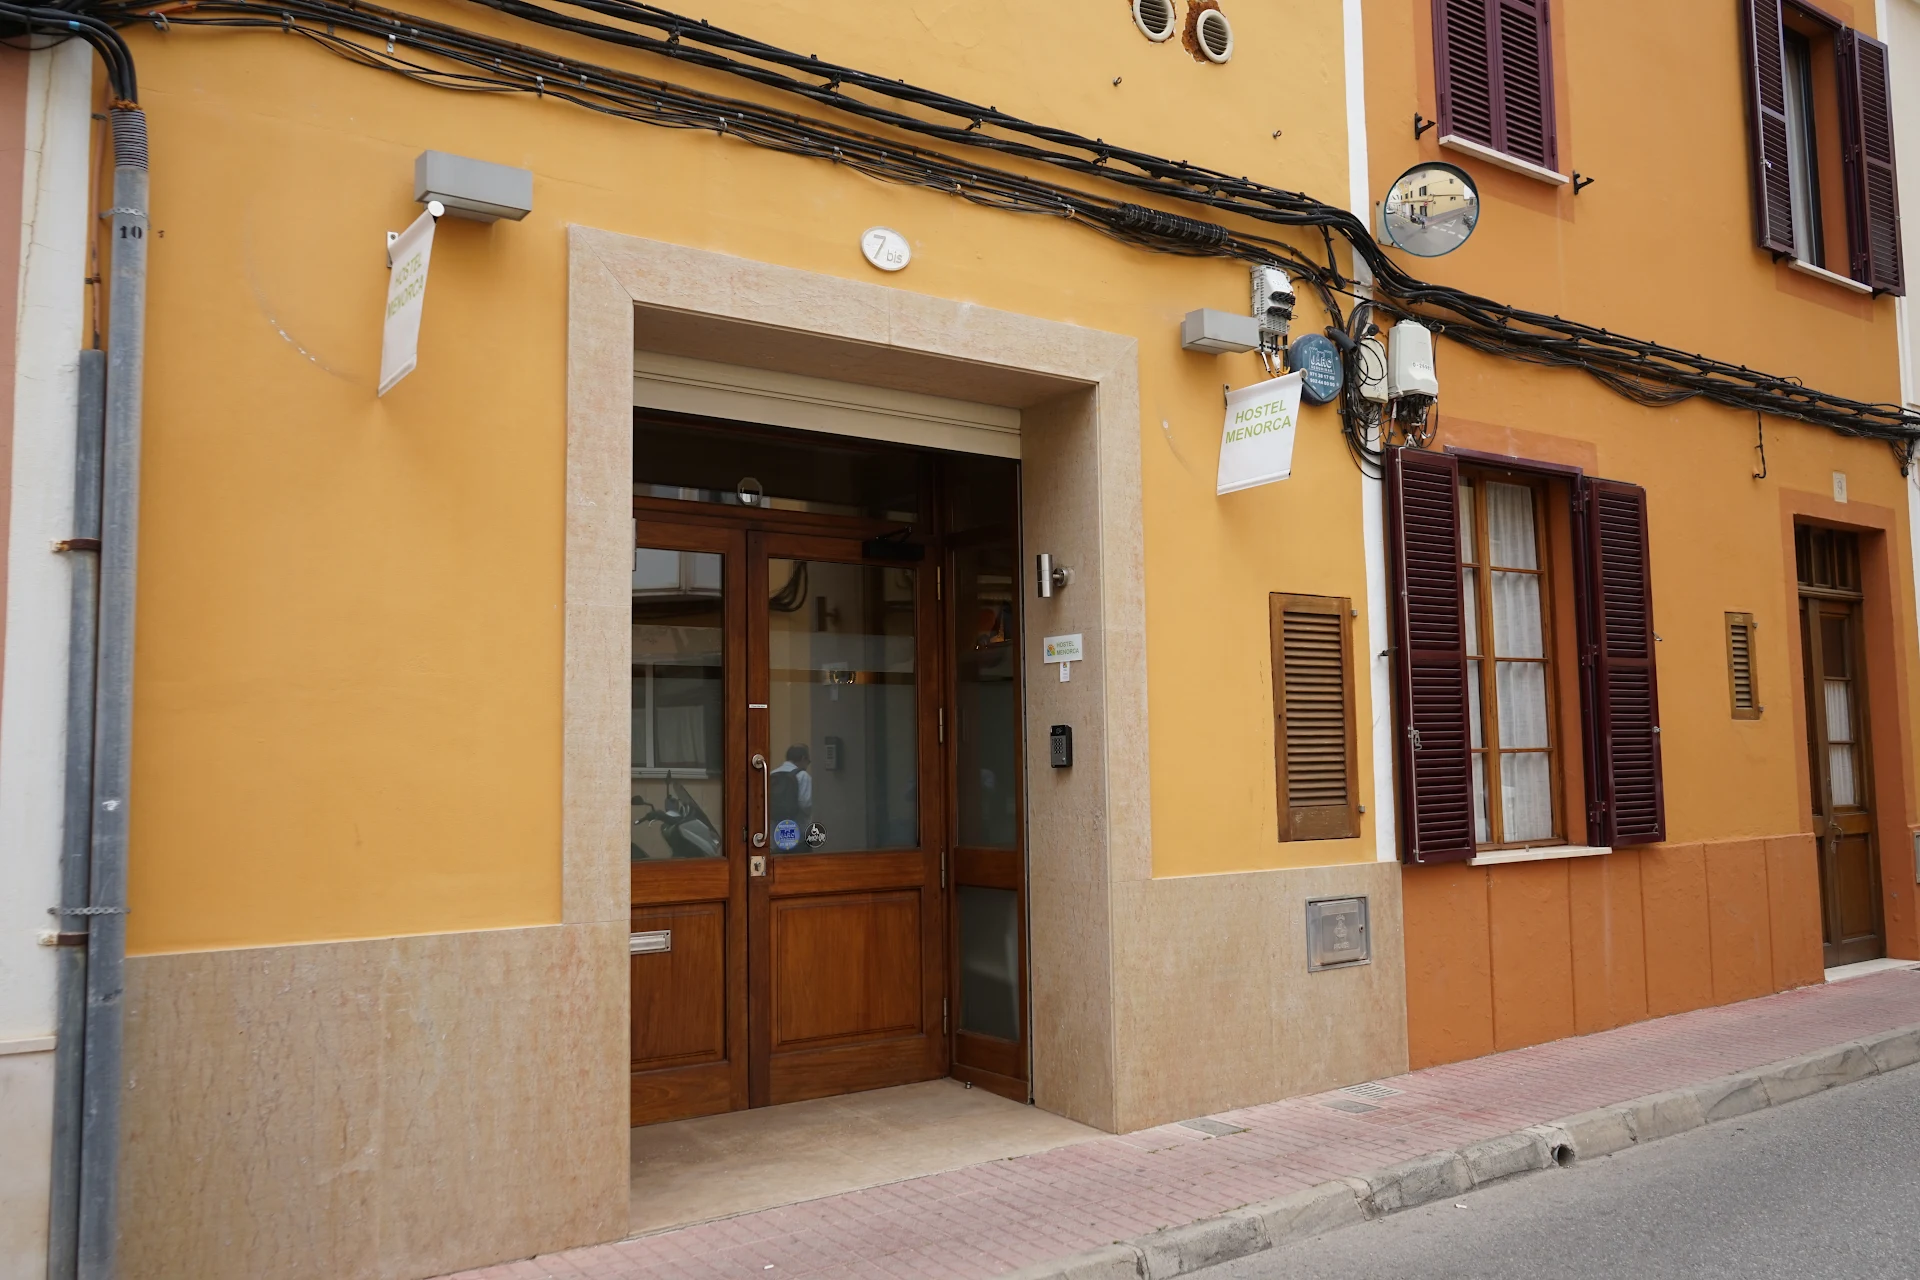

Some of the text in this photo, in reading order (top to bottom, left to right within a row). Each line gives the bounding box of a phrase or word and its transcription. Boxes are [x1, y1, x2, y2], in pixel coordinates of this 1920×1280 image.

[120, 225, 142, 239] 10
[873, 234, 902, 264] 7 bis
[1235, 400, 1286, 424] HOSTEL
[1225, 415, 1291, 443] MENORCA
